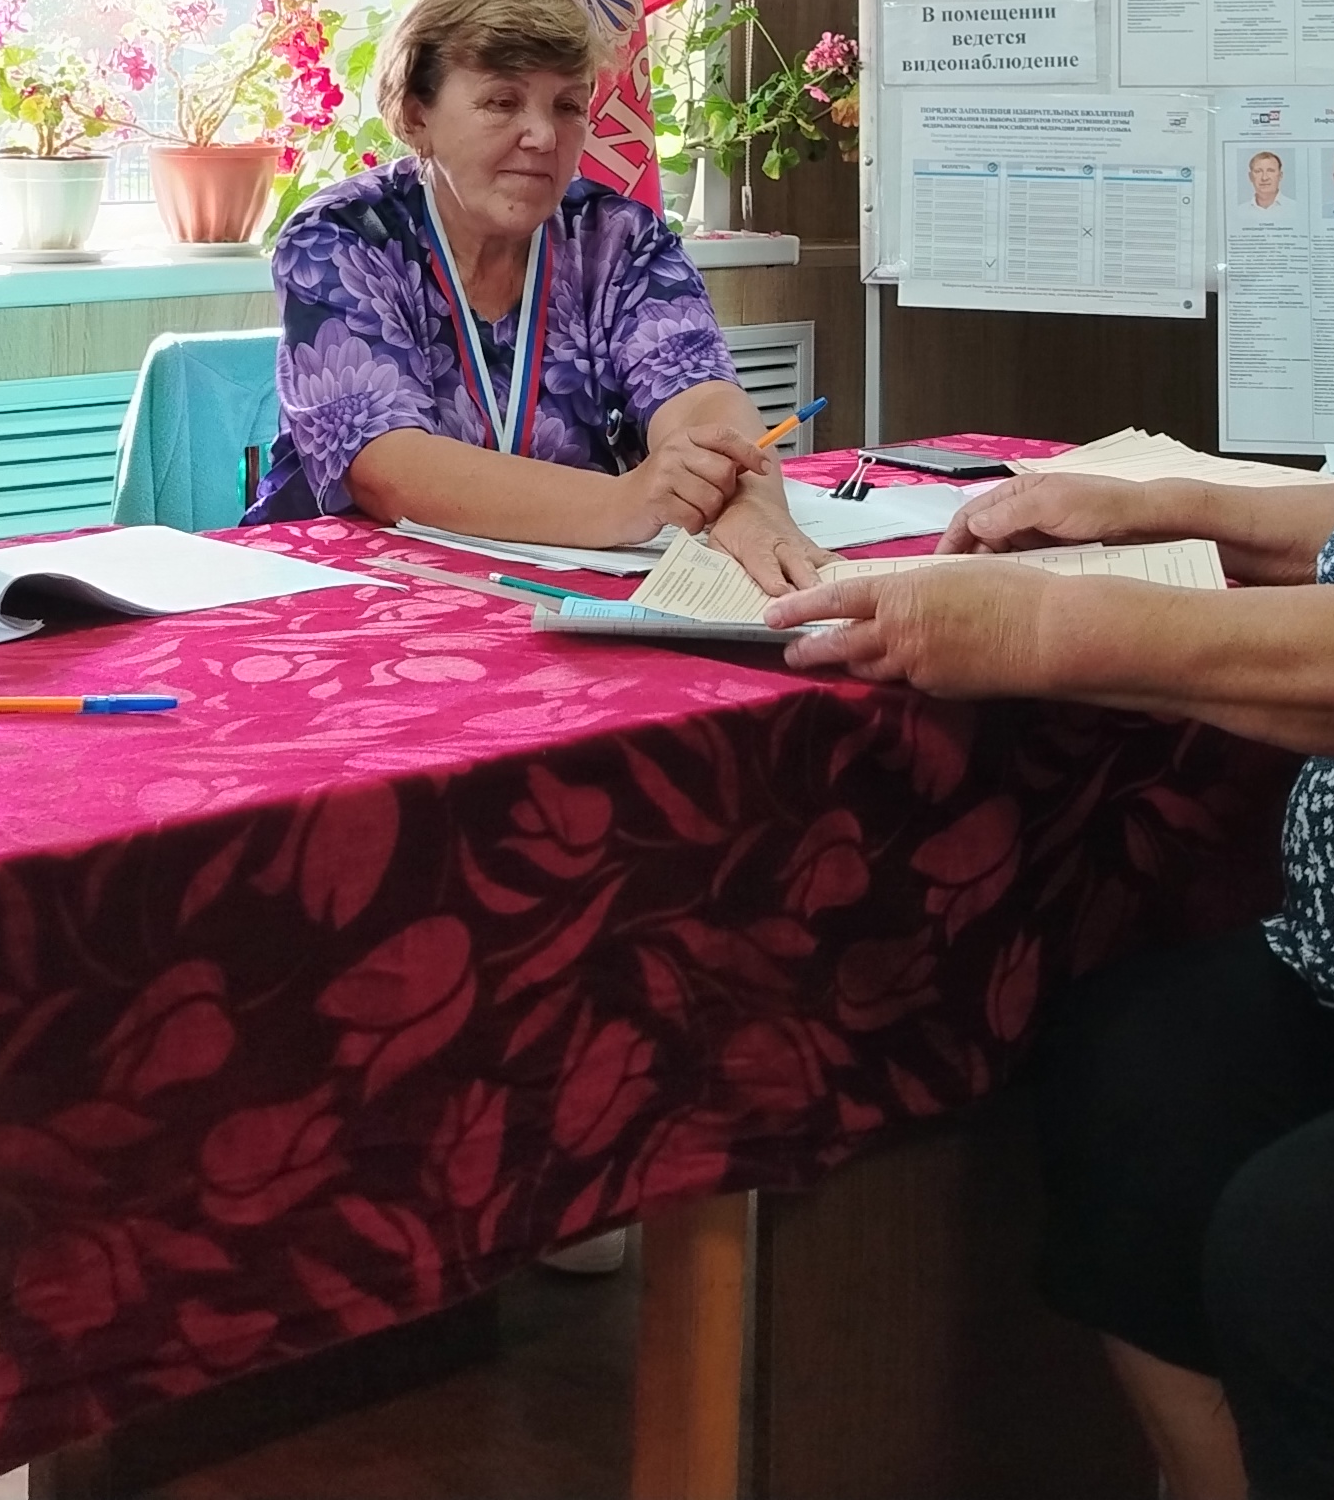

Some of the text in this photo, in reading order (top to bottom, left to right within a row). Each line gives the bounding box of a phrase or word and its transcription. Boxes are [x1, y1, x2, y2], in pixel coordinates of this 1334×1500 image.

[922, 7, 1056, 22] В помещении
[952, 33, 1026, 47] ведется
[902, 54, 1079, 73] видеонаблюдение
